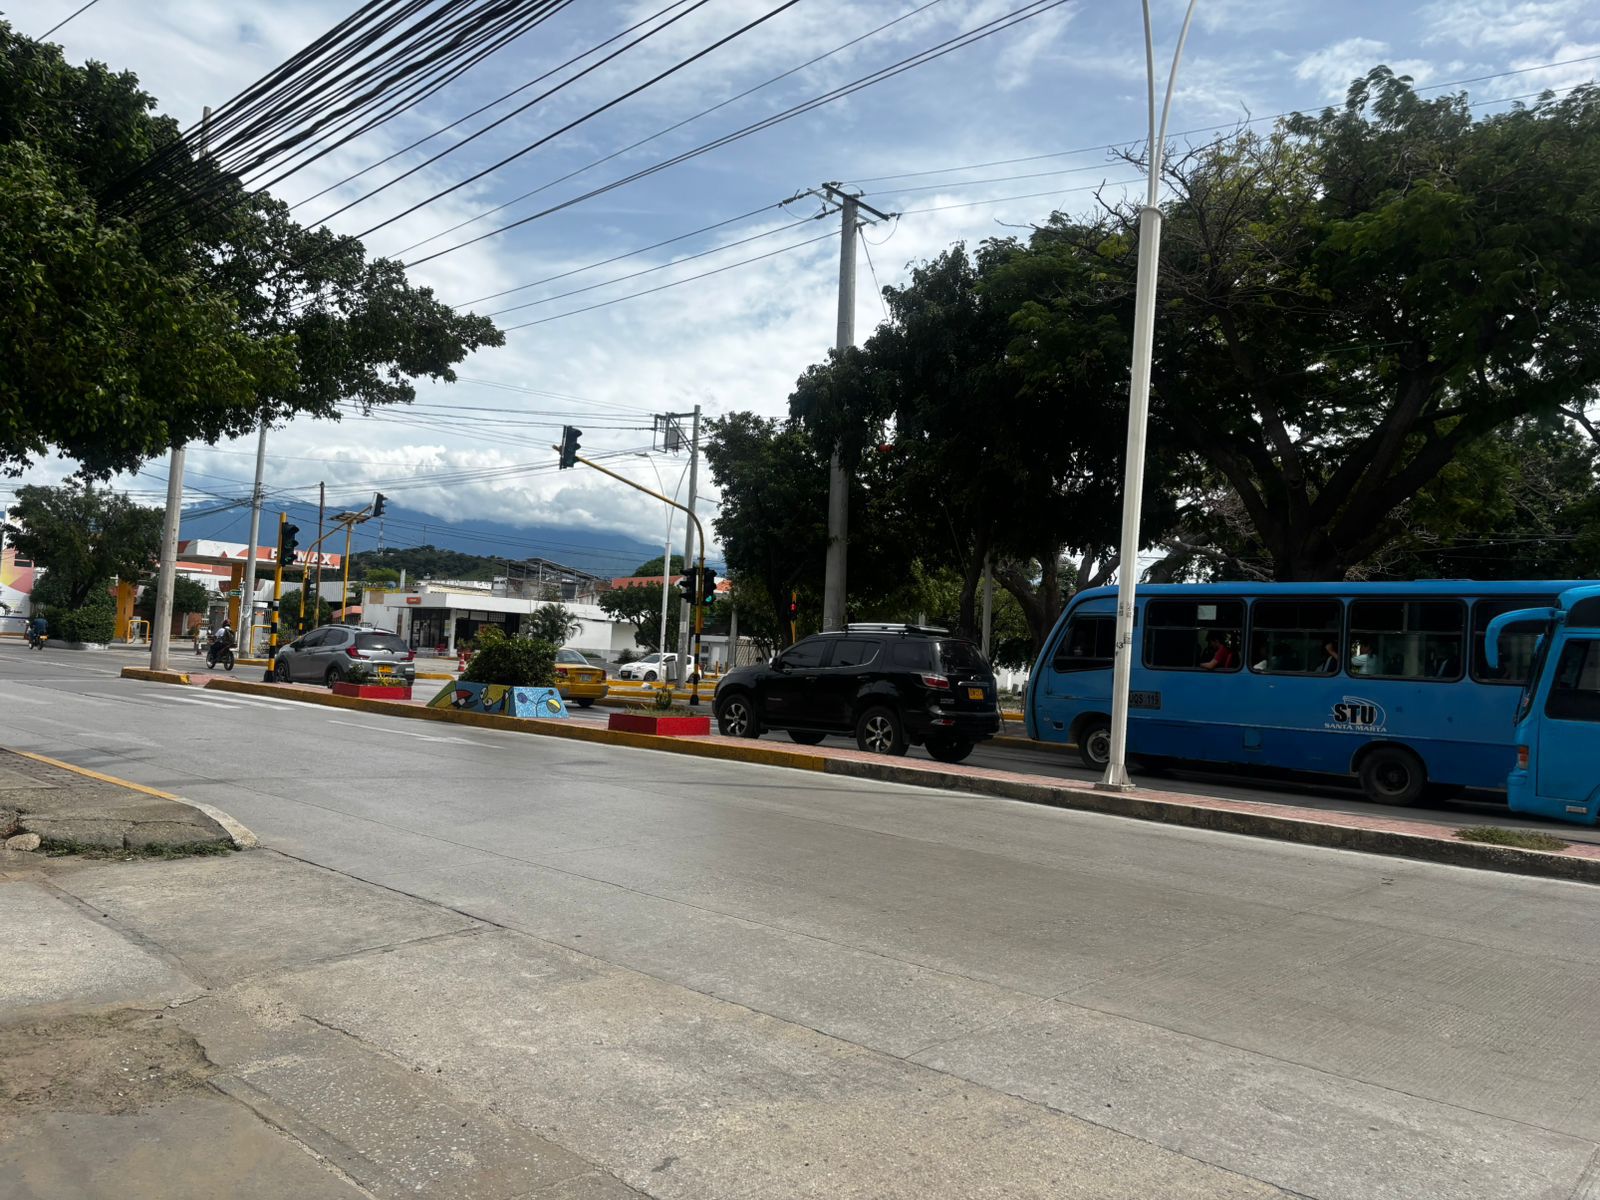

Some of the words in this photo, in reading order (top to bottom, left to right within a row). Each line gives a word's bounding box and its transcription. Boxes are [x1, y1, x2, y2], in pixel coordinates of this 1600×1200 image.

[271, 547, 332, 565] PMAX
[1334, 703, 1375, 724] STU
[1324, 722, 1353, 730] SANTA
[1355, 725, 1387, 733] MARTA
